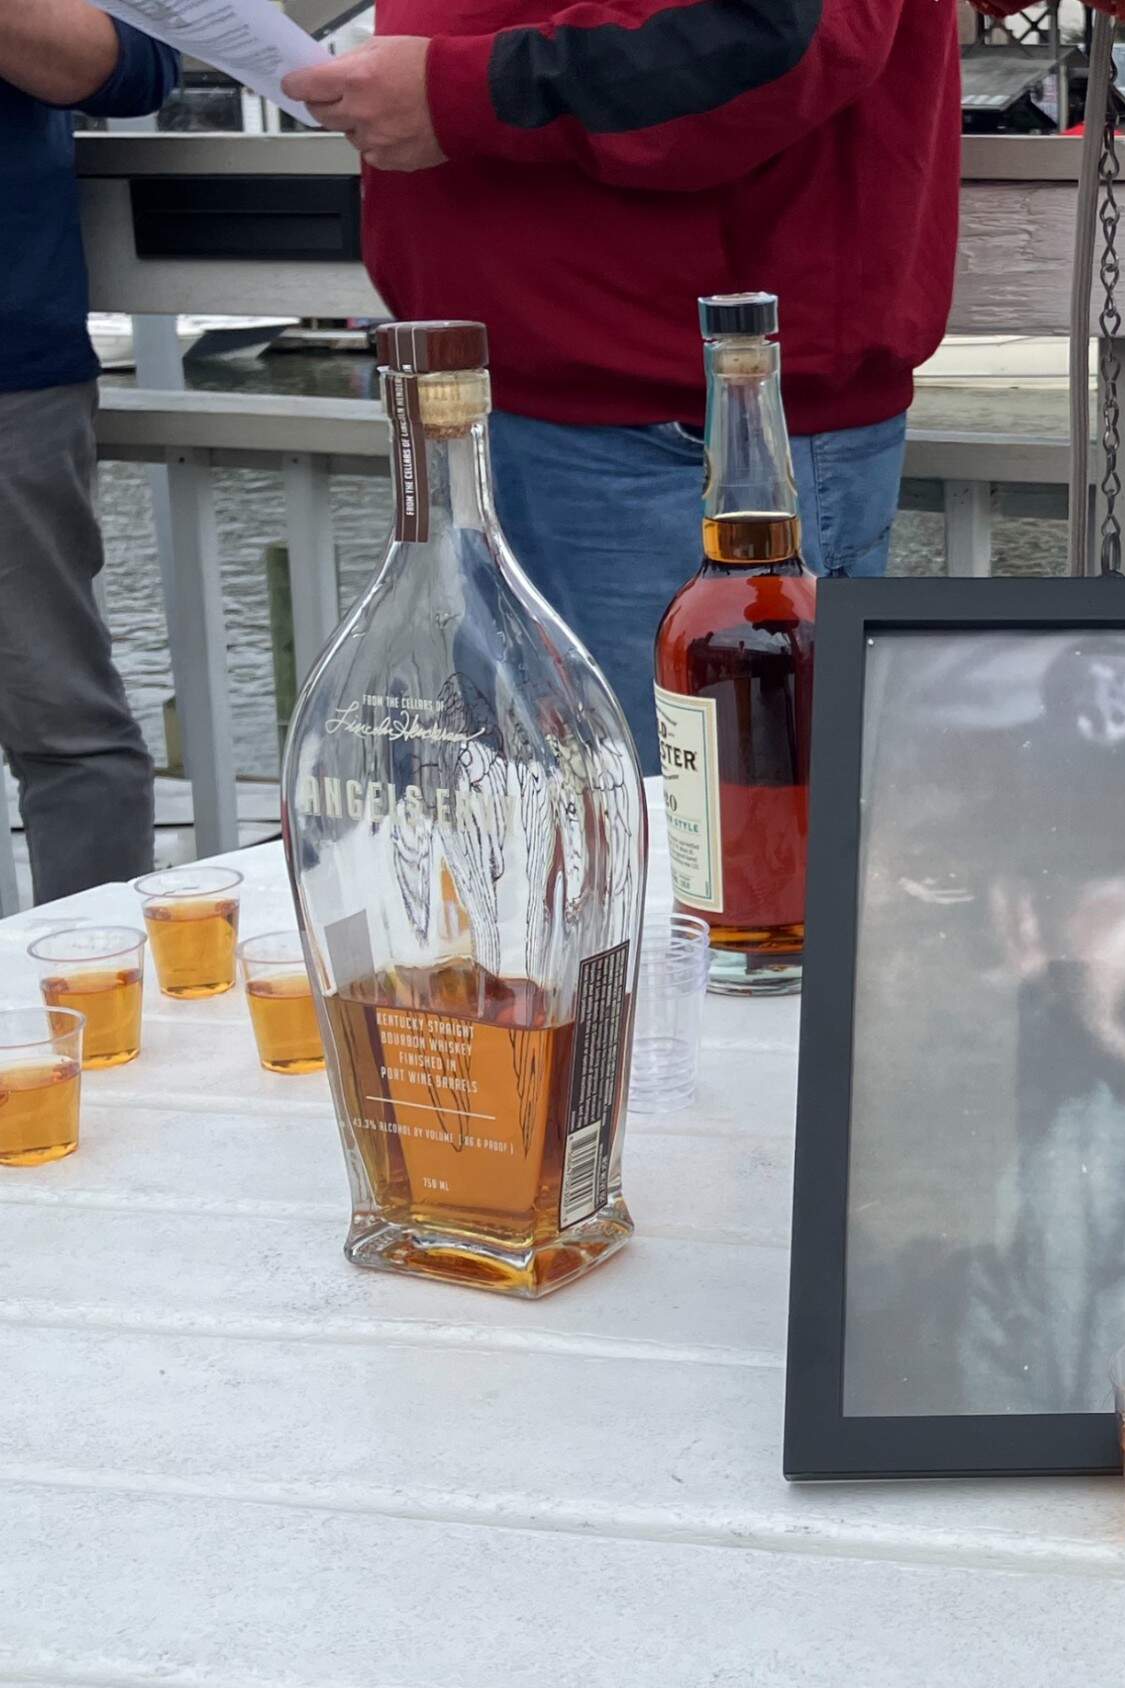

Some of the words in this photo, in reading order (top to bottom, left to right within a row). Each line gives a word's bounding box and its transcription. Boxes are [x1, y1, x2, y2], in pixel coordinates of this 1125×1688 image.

[402, 449, 413, 479] CELLARS
[403, 481, 414, 494] THE
[405, 495, 415, 516] FROM
[362, 694, 384, 708] FROM
[386, 696, 399, 708] THE
[401, 698, 433, 711] CELLARS
[660, 740, 697, 771] STER
[376, 1011, 424, 1032] KENTUCKY
[428, 1020, 475, 1040] STRAIGHT
[380, 1031, 426, 1050] BOURBON
[429, 1038, 473, 1056] WHISKEY
[399, 1051, 443, 1071] FINISHED
[446, 1058, 457, 1072] IN
[380, 1065, 405, 1080] PORT
[408, 1071, 433, 1087] WINE
[435, 1075, 480, 1094] BARRELS
[378, 1121, 411, 1137] ALCOHOL
[413, 1126, 424, 1138] BY
[425, 1128, 454, 1144] VOLUME
